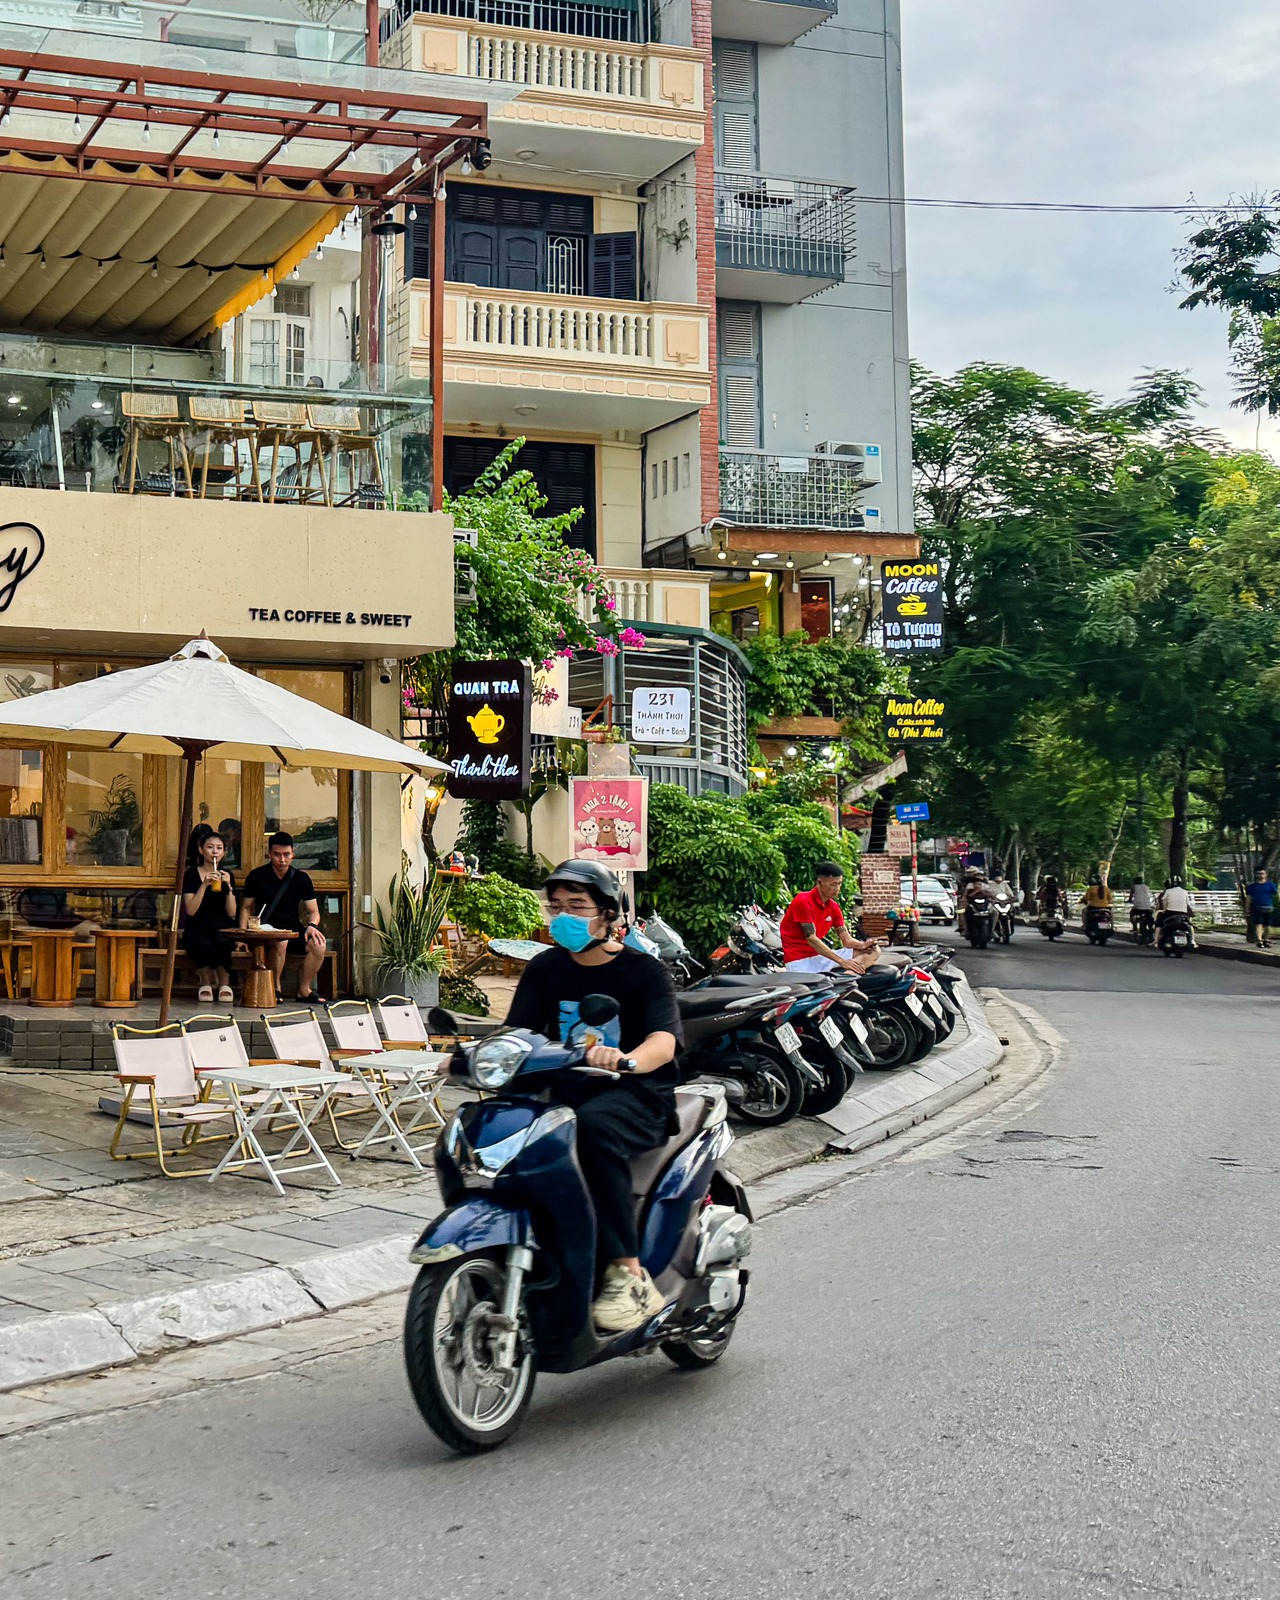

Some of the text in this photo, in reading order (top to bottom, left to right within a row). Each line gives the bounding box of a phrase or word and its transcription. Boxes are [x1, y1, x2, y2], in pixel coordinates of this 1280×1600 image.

[885, 564, 938, 577] MOON
[885, 578, 938, 594] Coffee
[249, 608, 412, 627] TEA COFFEE & SWEET
[649, 693, 674, 706] 231
[886, 699, 945, 716] Moon Coffee
[582, 797, 600, 814] MUA
[600, 795, 607, 804] 2
